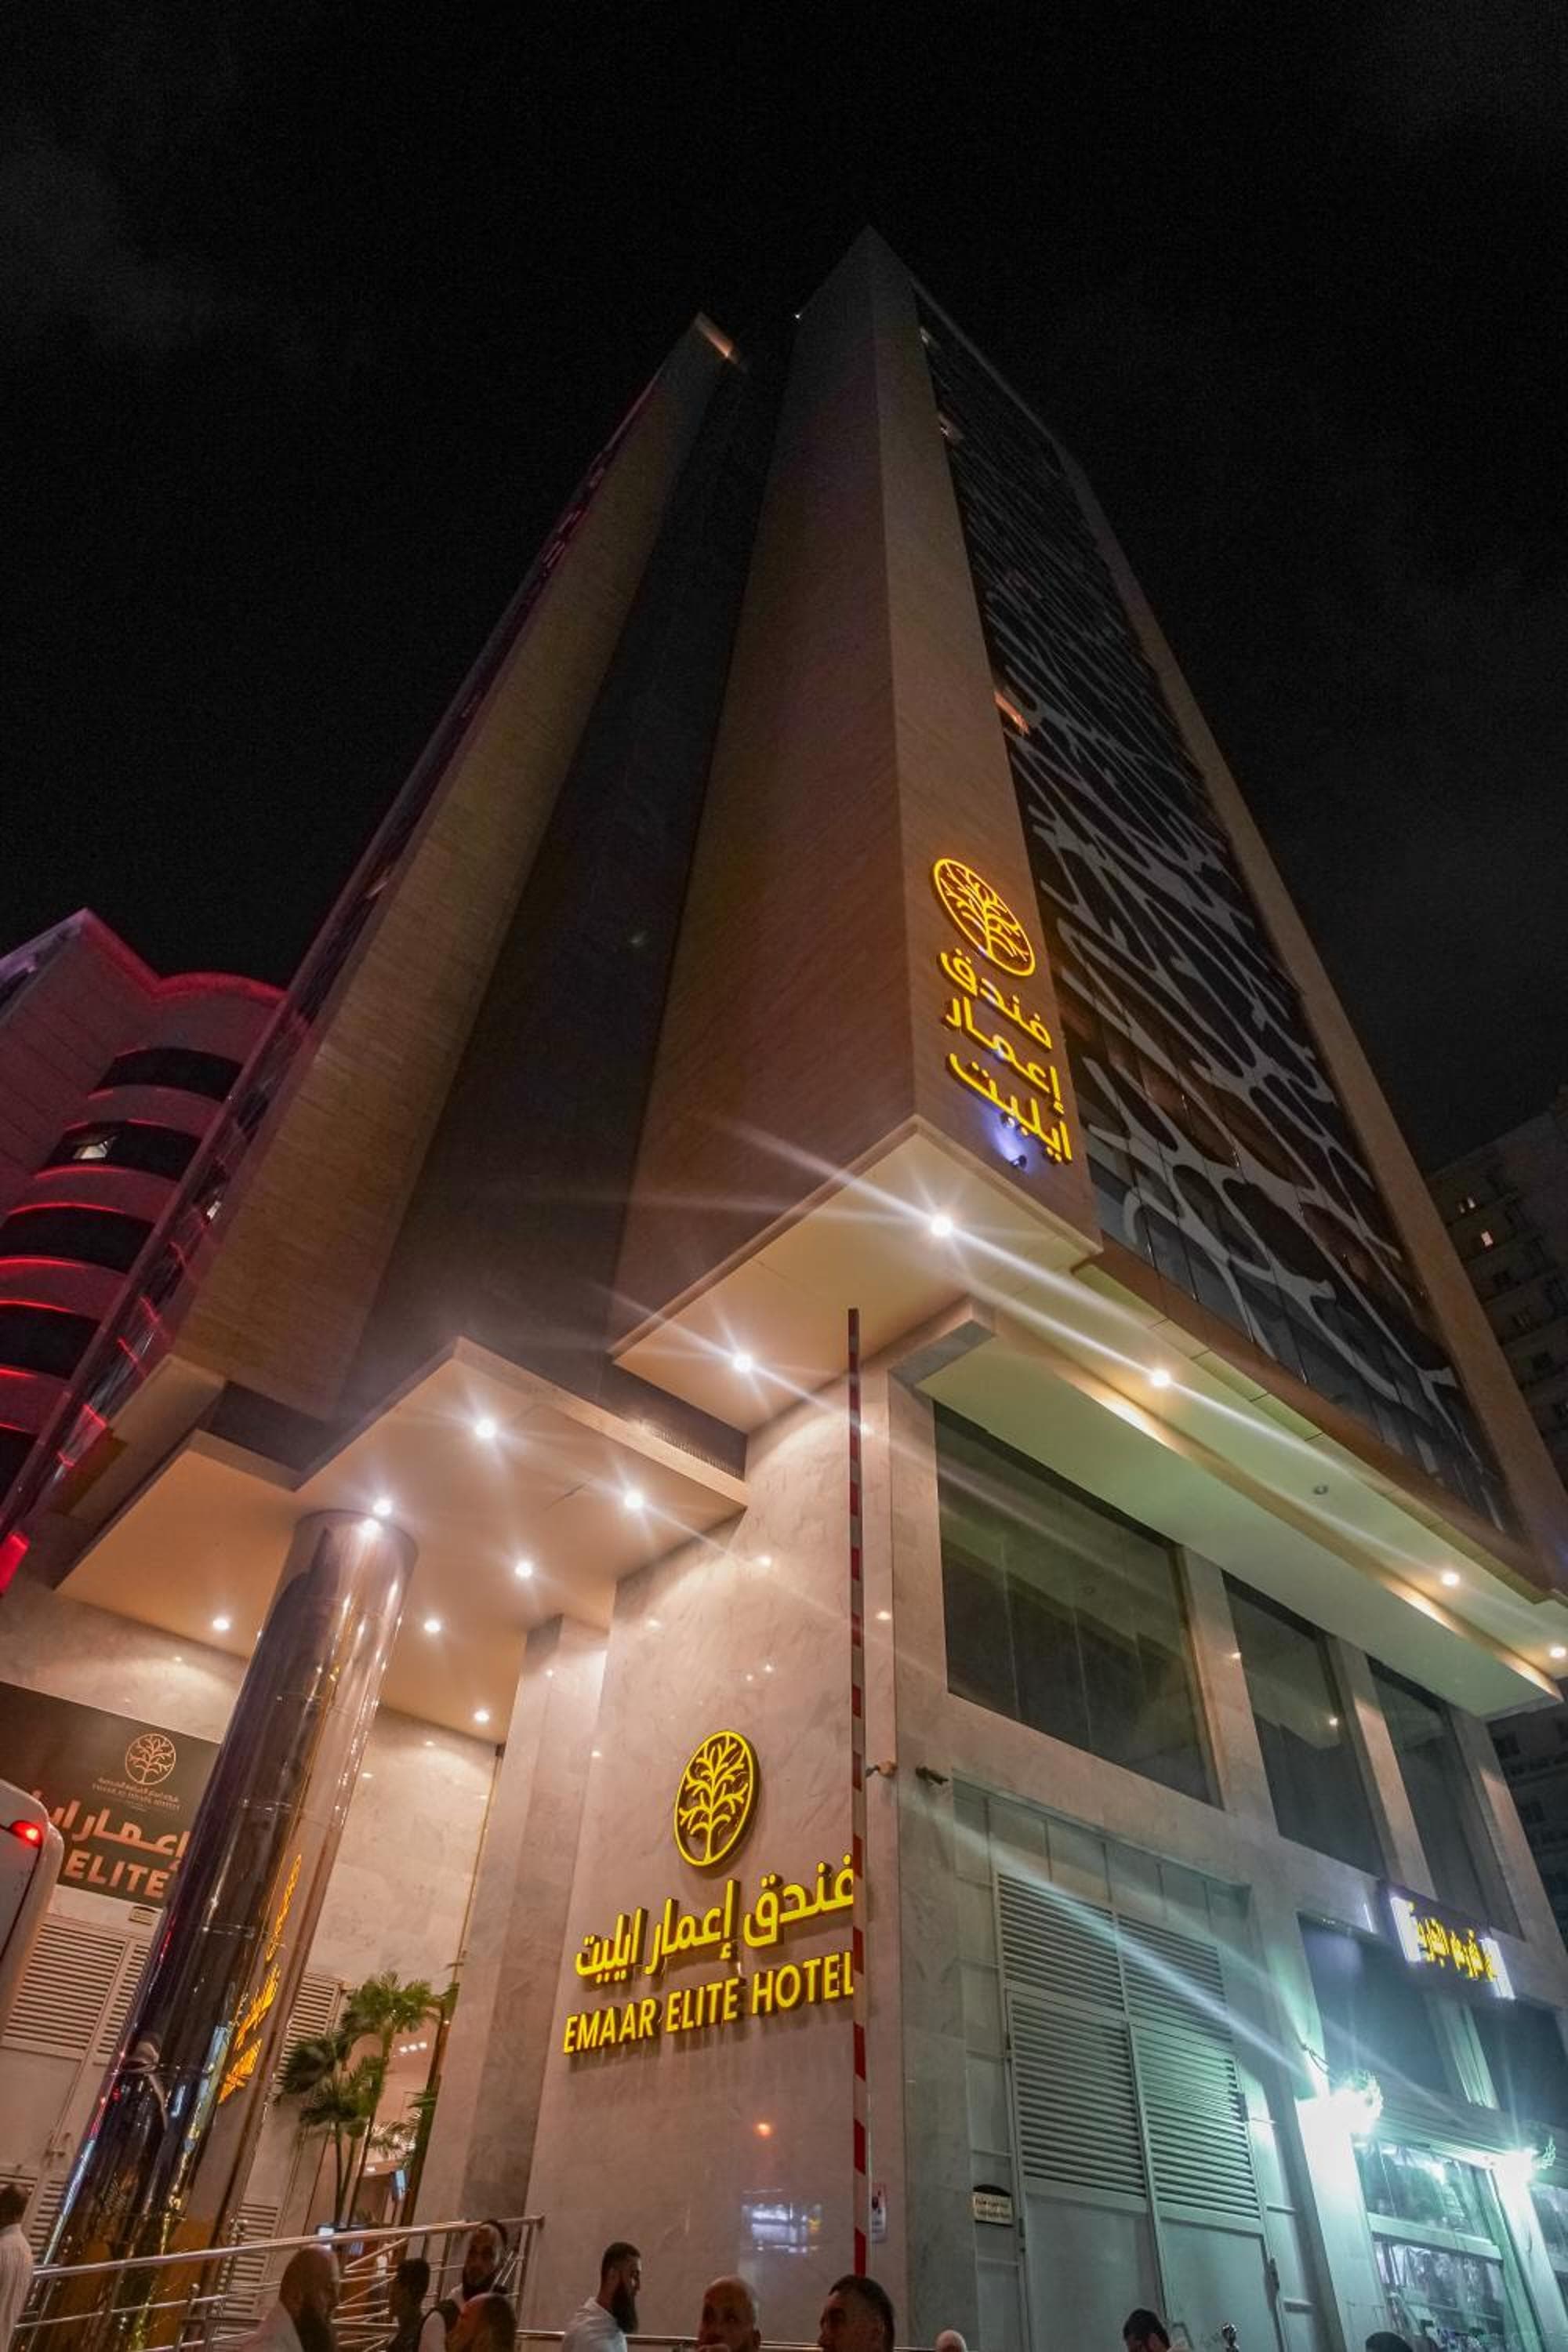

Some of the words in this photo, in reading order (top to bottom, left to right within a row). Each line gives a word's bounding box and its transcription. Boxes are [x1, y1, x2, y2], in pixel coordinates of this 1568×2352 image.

[941, 948, 1052, 1049] فندق
[946, 996, 1065, 1115] إعمار
[64, 1849, 169, 1898] ELITE
[742, 1853, 854, 1947] فندق
[644, 1880, 735, 1976] إعمار
[563, 1998, 657, 2054] EMAAR
[666, 1978, 740, 2034] ELITE
[752, 1951, 854, 2016] HOTEL
